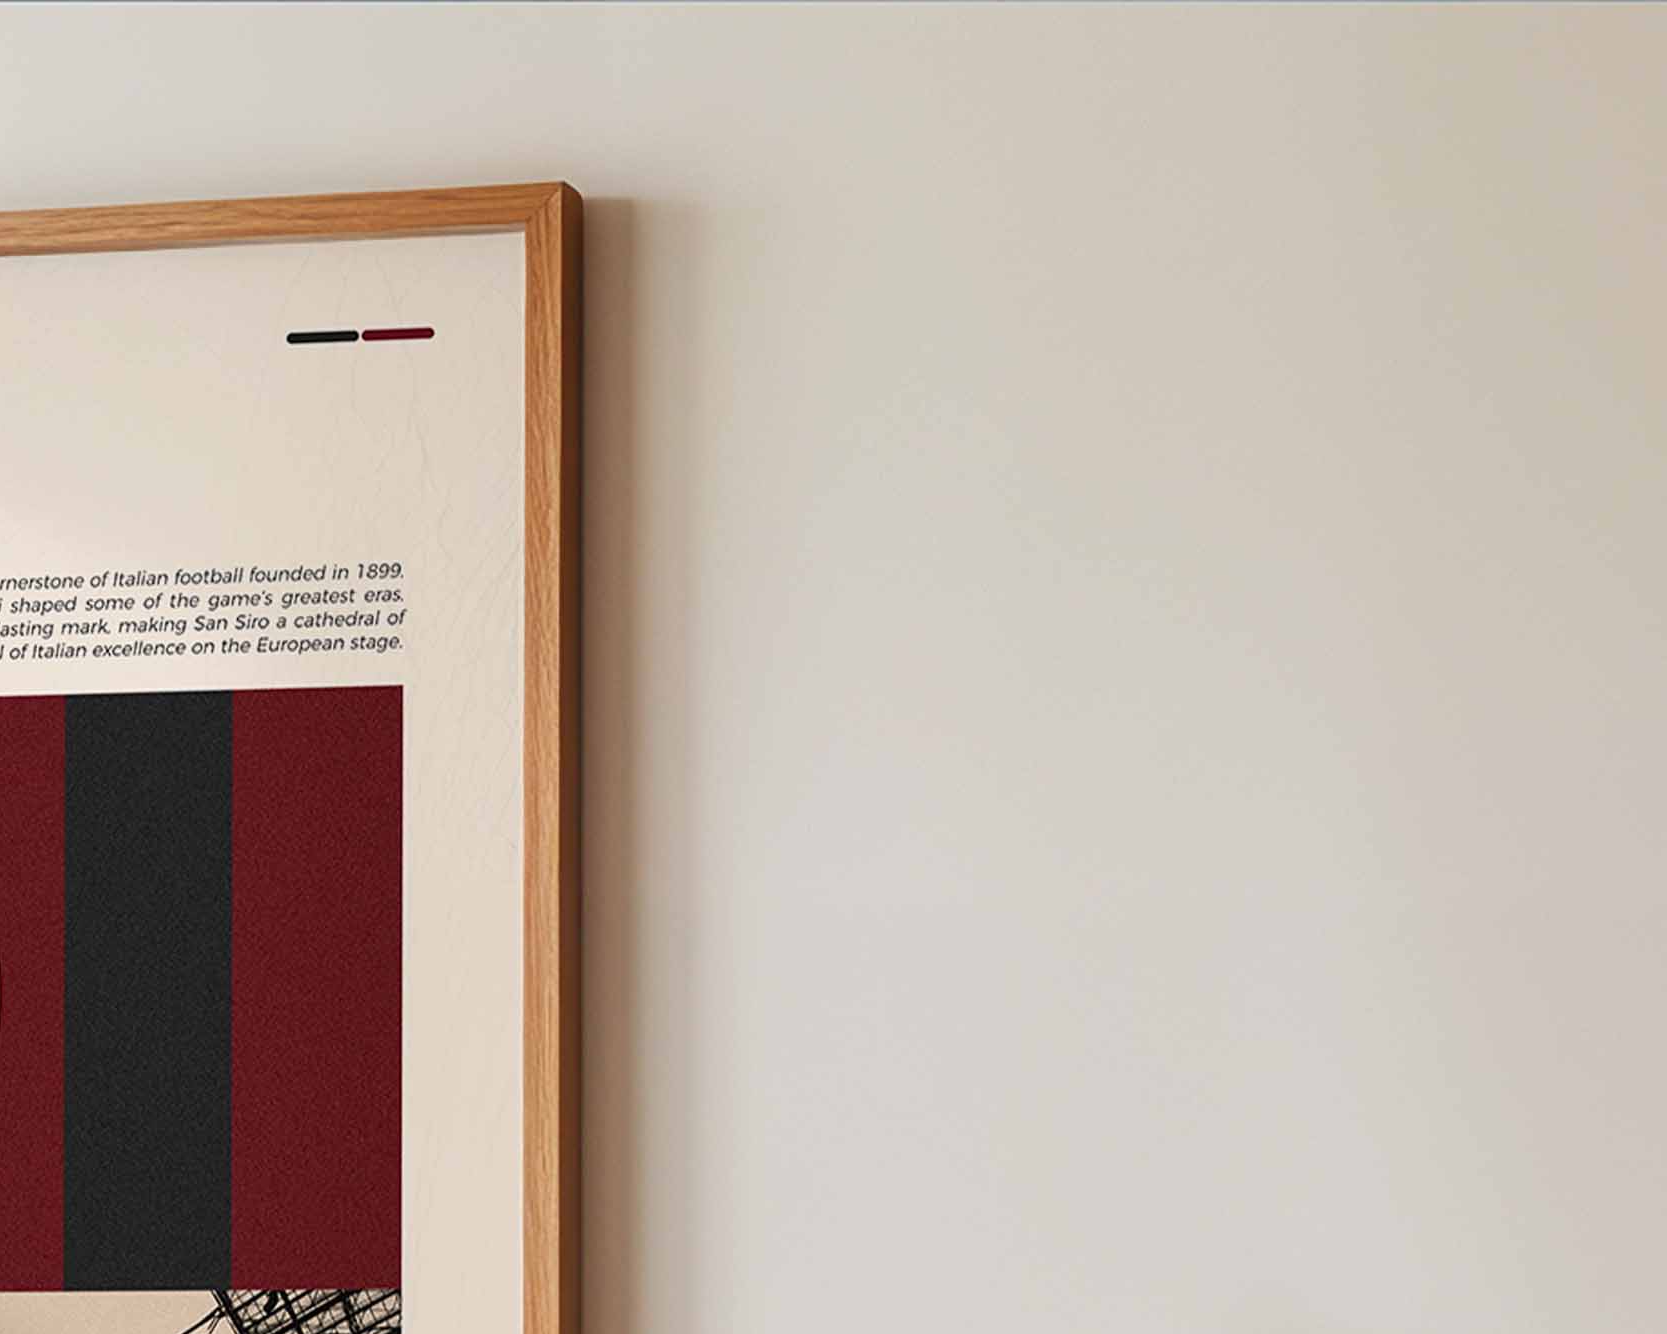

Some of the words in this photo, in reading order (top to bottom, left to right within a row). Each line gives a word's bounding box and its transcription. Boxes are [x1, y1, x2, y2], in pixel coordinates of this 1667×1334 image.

[90, 571, 109, 588] of
[113, 570, 169, 587] Italian
[175, 567, 244, 585] football
[249, 564, 327, 583] founded
[332, 564, 349, 580] in
[358, 562, 404, 580] 1899.
[10, 596, 77, 616] shaped
[85, 598, 135, 611] some
[143, 592, 163, 610] of
[170, 593, 200, 609] the
[281, 589, 355, 610] greatest
[364, 589, 403, 603] eras.
[118, 616, 187, 636] making
[194, 615, 228, 632] San
[235, 613, 270, 630] Siro
[276, 616, 287, 629] a
[293, 610, 380, 629] cathedral
[387, 609, 407, 626] of
[9, 643, 29, 660] of
[32, 642, 87, 659] Italian
[92, 640, 186, 658] excellence
[191, 642, 215, 655] on
[221, 638, 251, 654] the
[257, 636, 345, 655] European
[350, 636, 403, 654] stage.
